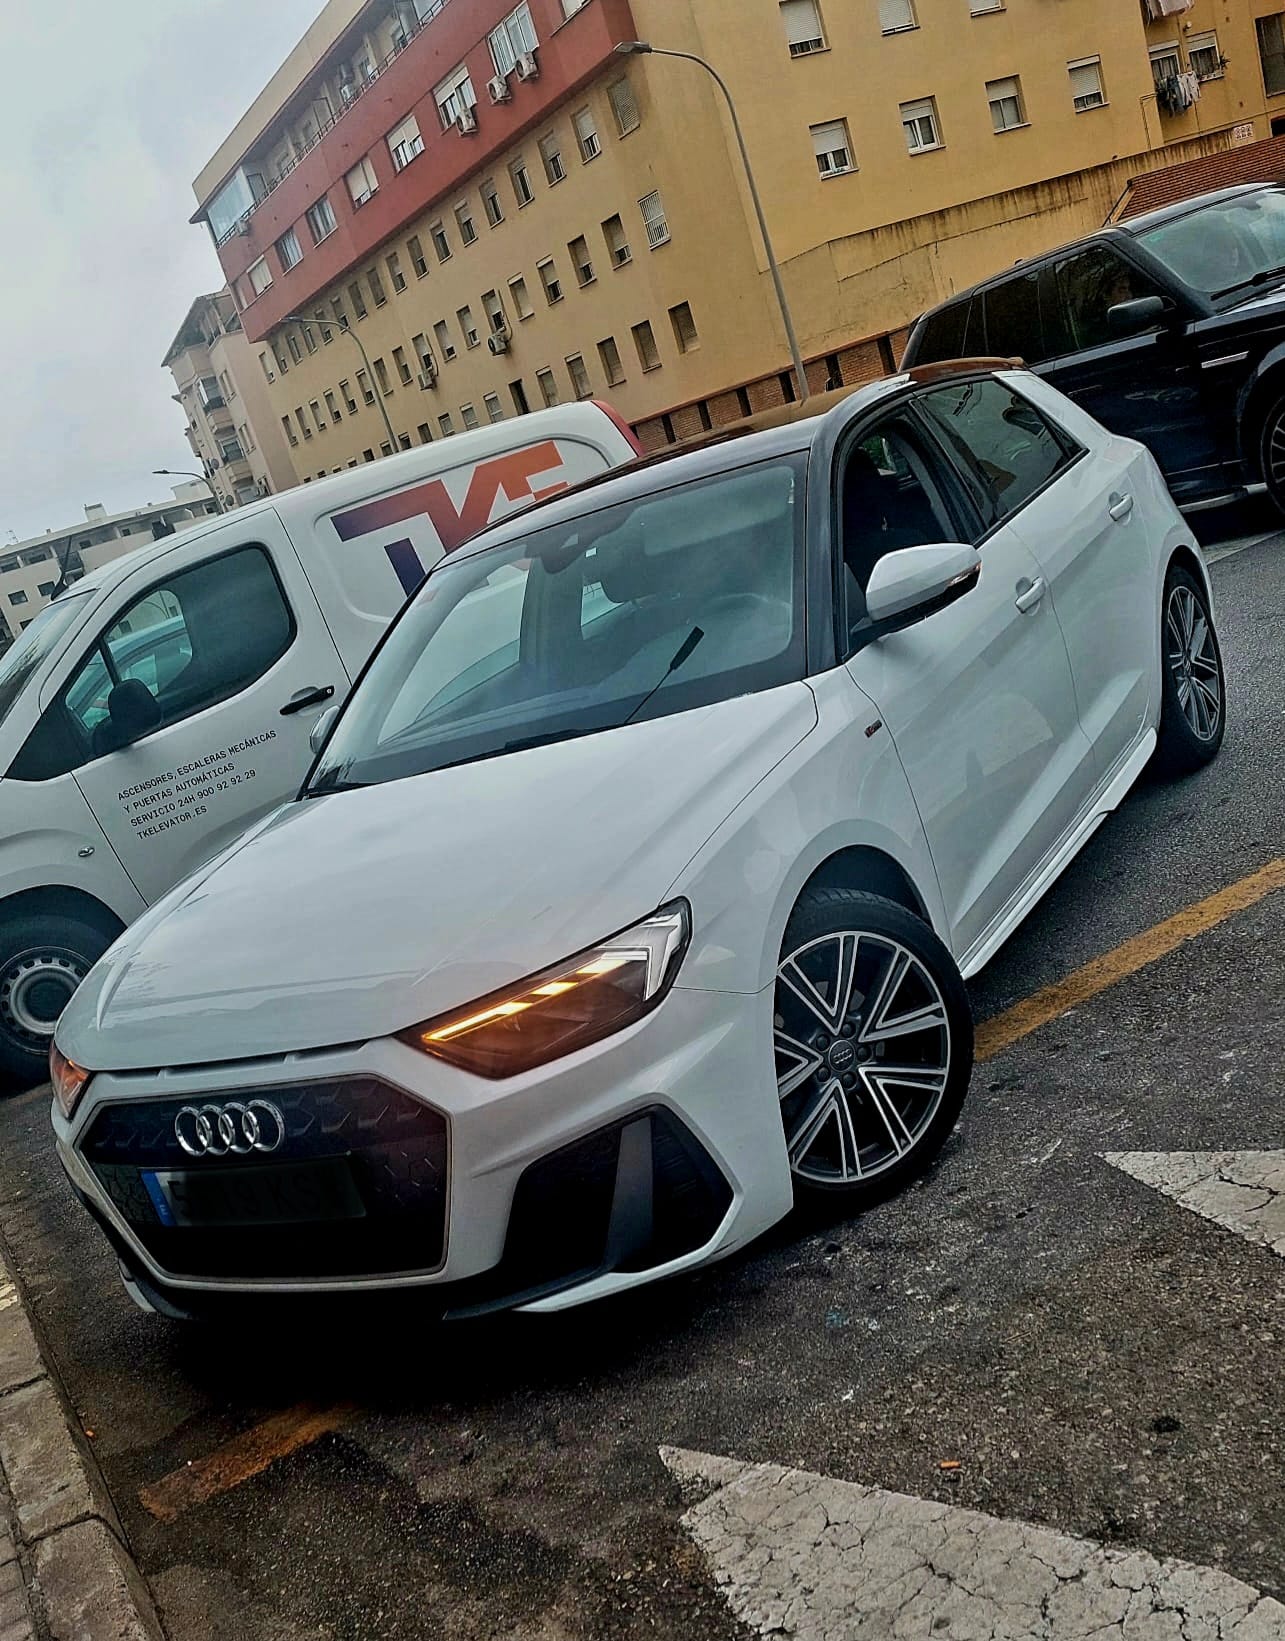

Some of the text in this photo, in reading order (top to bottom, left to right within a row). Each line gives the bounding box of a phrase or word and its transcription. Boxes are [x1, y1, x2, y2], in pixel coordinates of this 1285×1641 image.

[118, 730, 277, 801] ASCENSORES, ESCALERAS MECÁNICAS
[123, 762, 235, 814] Y PUERTAS AUTOMÁTICAS
[130, 769, 256, 827] SERVICIO 24H 900 92 92 29
[136, 805, 208, 840] TKELEVATOR.ES
